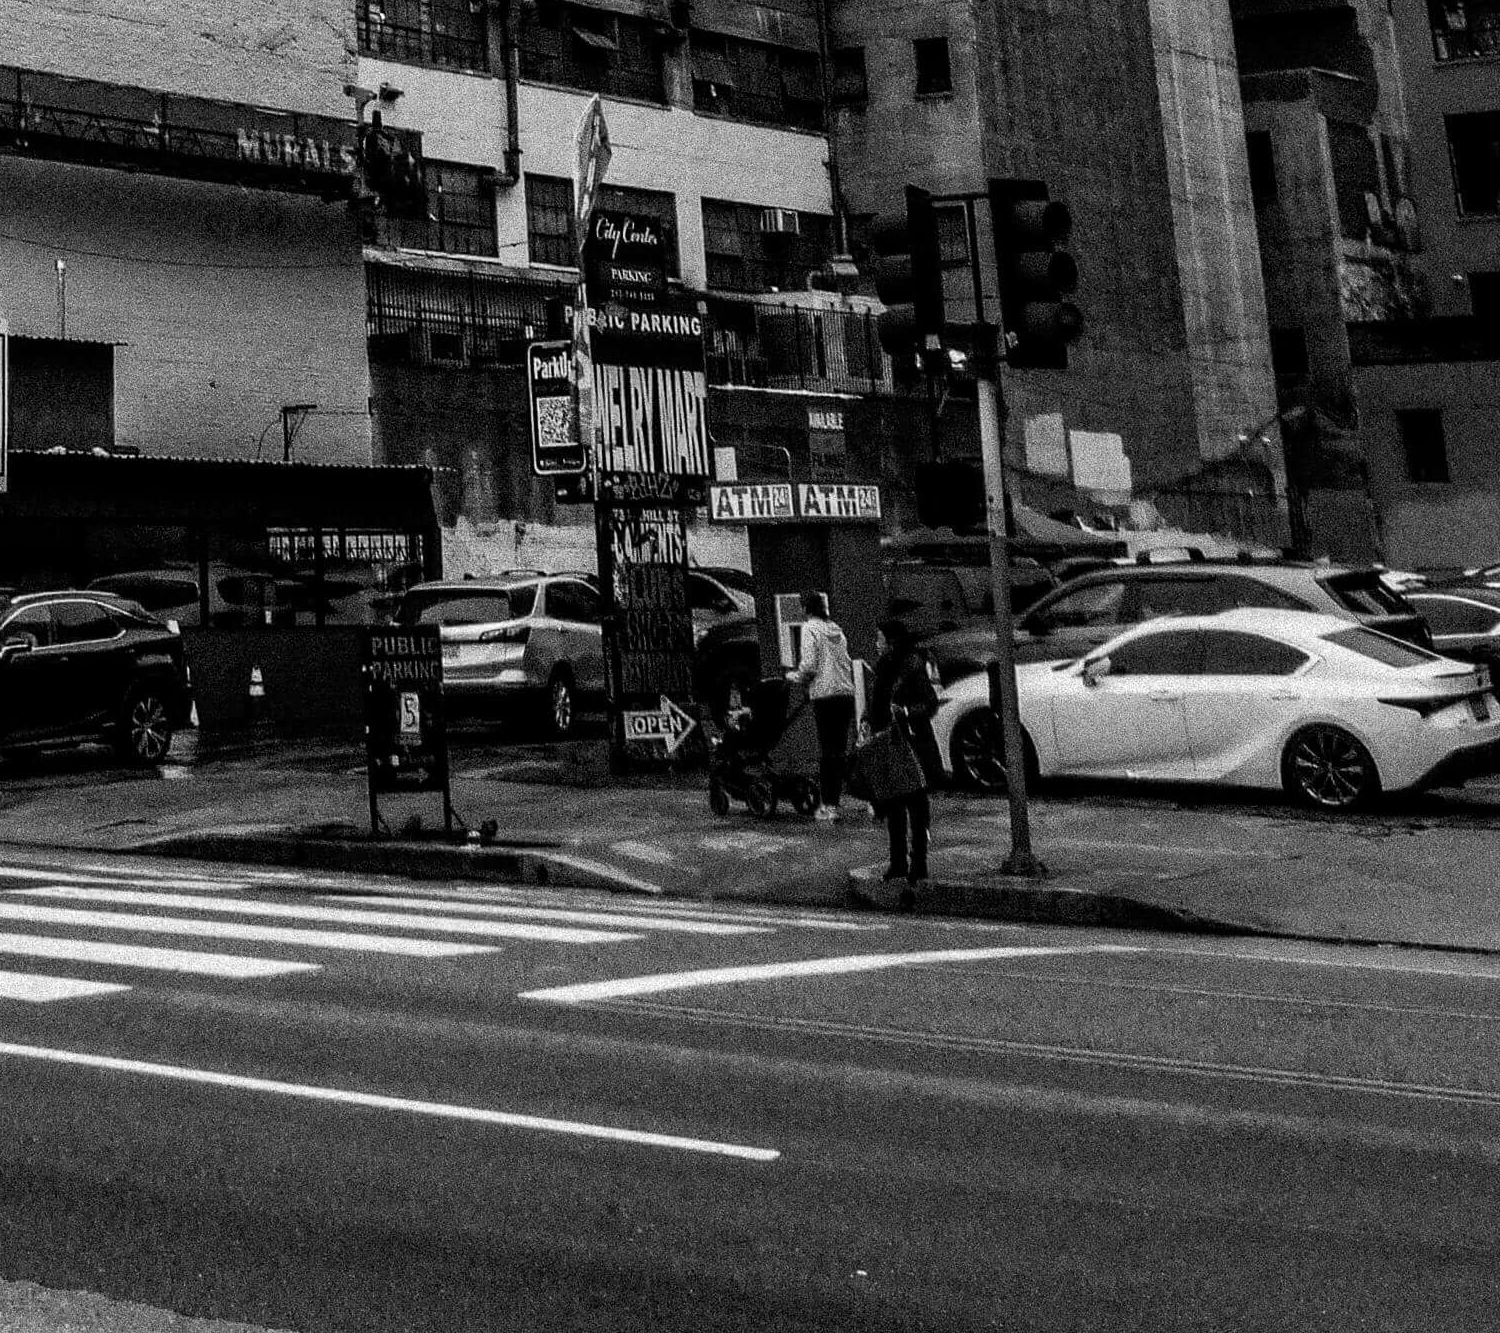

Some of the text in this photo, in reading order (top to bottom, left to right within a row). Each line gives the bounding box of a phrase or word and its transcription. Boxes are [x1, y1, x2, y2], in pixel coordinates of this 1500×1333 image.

[235, 127, 357, 175] MURALS
[610, 267, 652, 283] PARKING
[563, 304, 702, 336] PBIC PARKING
[656, 367, 710, 477] MART
[716, 488, 772, 517] ATM
[804, 486, 857, 515] ATM
[370, 636, 438, 656] PUBLIC
[634, 716, 683, 734] OPEN
